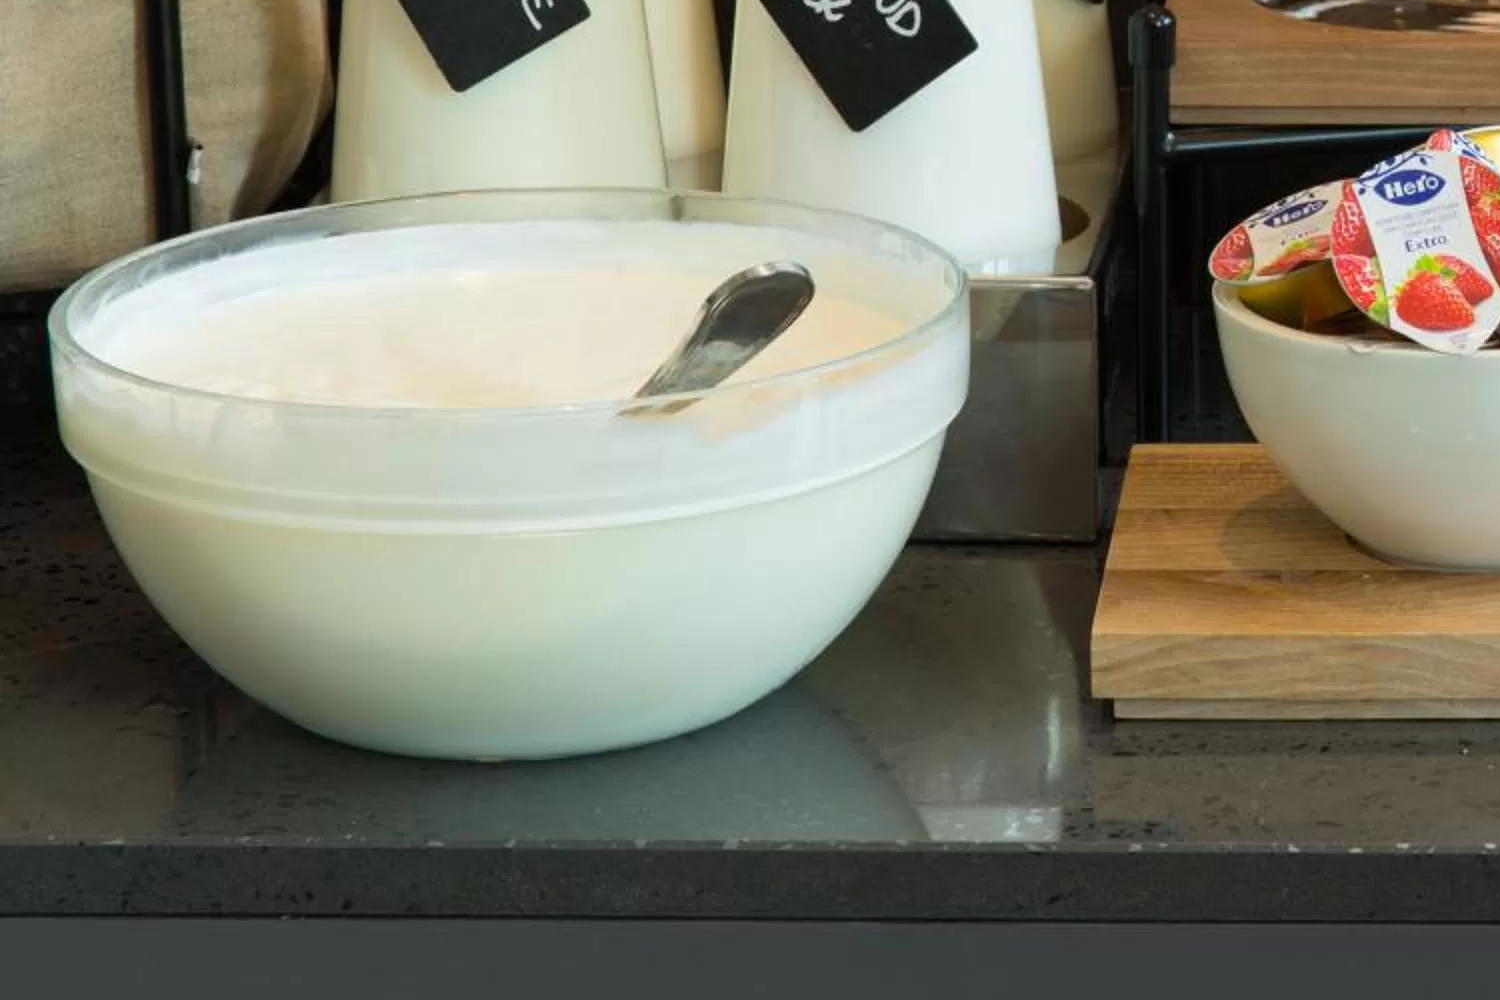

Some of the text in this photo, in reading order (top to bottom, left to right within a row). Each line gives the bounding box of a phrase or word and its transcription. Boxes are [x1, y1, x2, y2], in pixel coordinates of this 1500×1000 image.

[1383, 174, 1439, 199] Hero
[1272, 201, 1324, 226] Hero
[1405, 235, 1447, 252] Extra
